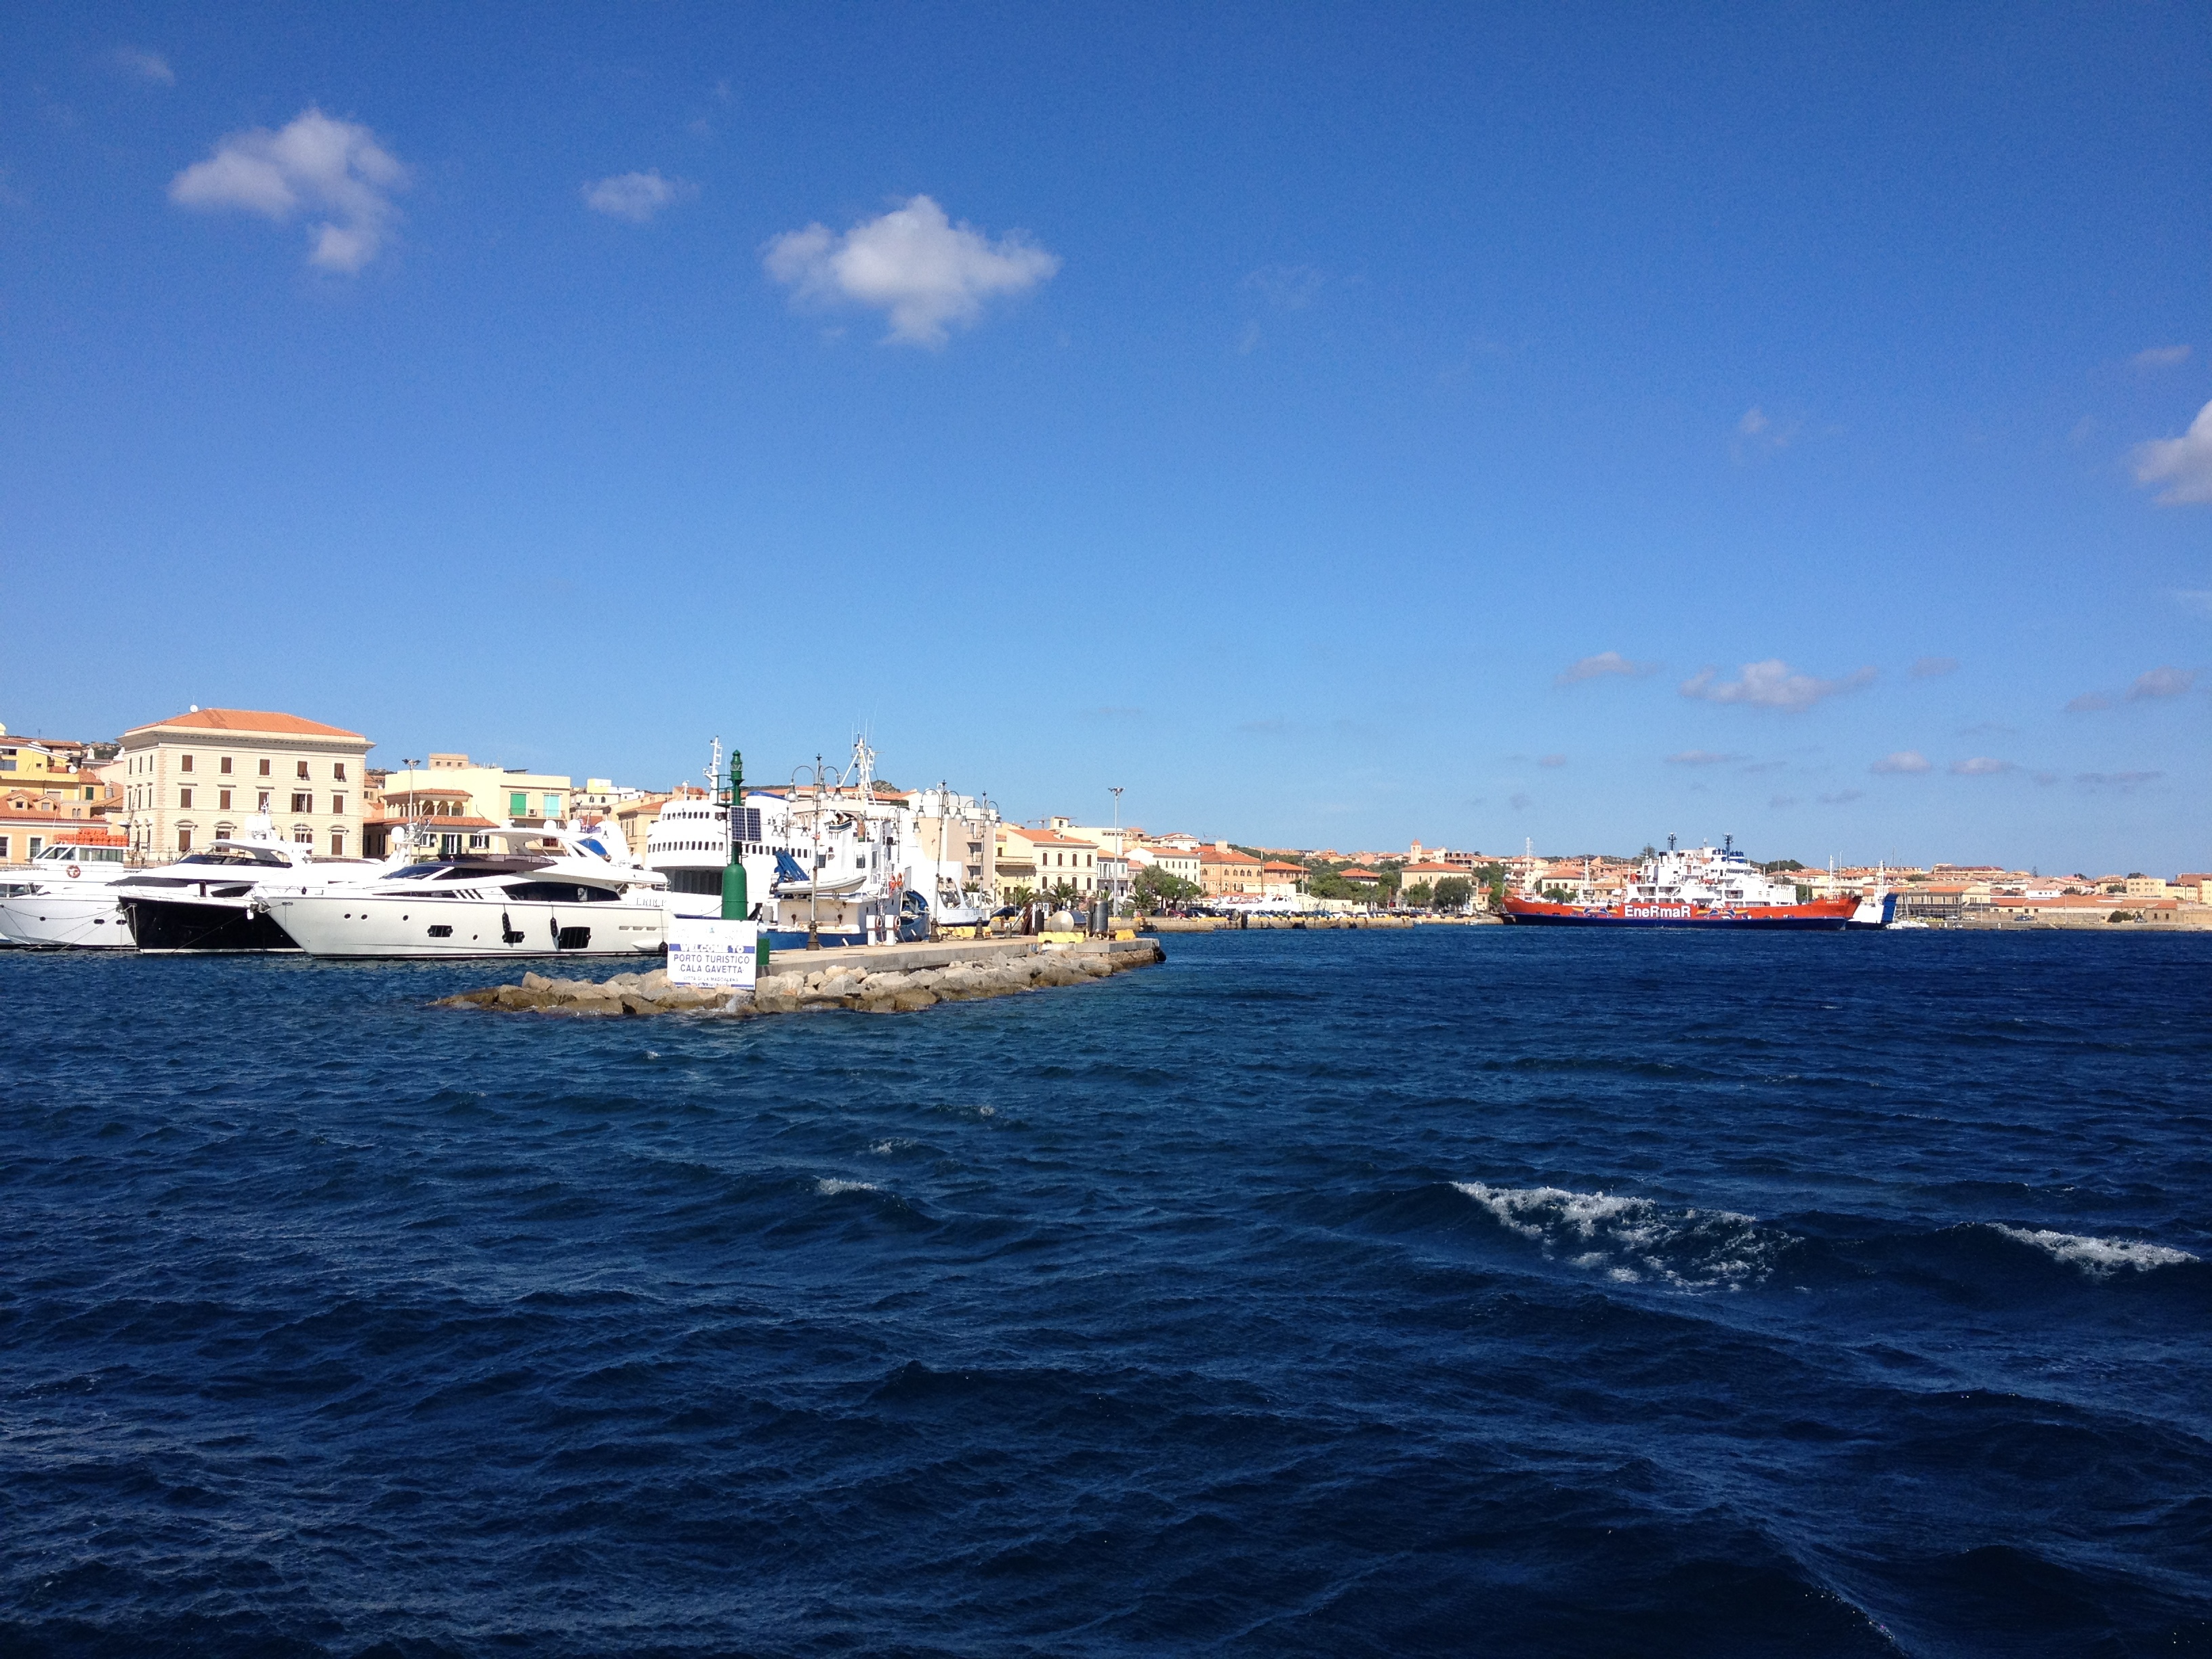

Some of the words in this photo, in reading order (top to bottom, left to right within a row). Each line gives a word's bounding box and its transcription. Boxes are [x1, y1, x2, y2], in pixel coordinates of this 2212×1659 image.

[1624, 905, 1691, 918] EneRmaR
[680, 944, 729, 953] WELCOME
[732, 945, 745, 954] TO
[674, 954, 702, 962] PORTO
[705, 955, 750, 964] TURISTICO
[680, 964, 701, 972] CALA
[705, 965, 743, 974] GAVETTA
